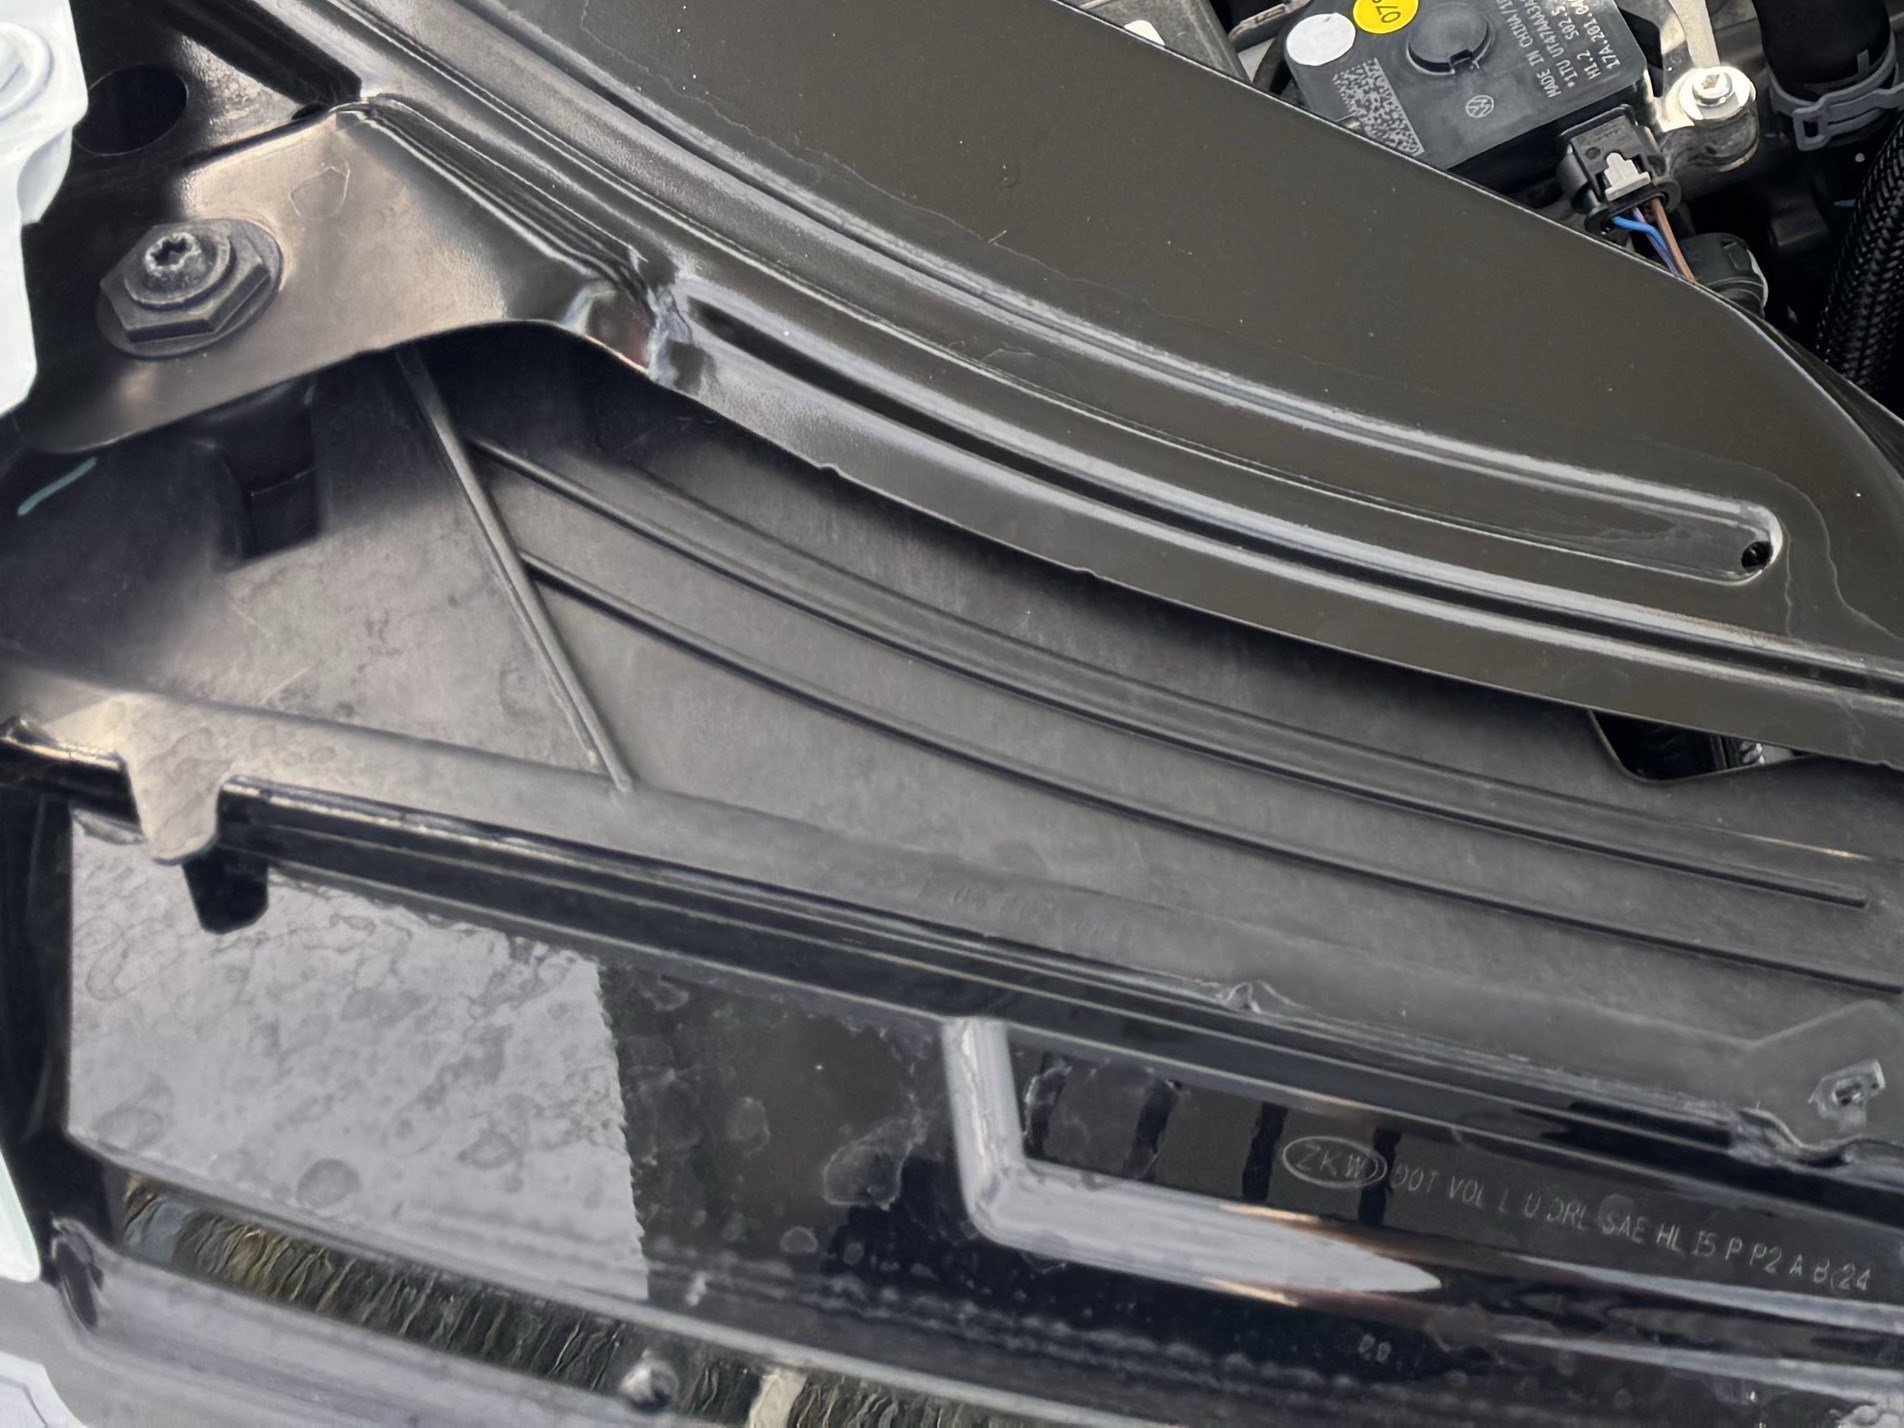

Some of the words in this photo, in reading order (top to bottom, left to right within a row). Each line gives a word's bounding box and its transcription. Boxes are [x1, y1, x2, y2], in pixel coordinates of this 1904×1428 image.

[1525, 48, 1544, 67] IN
[1536, 67, 1561, 99] MADE
[1295, 1143, 1368, 1181] ZKW
[1599, 1209, 1647, 1244] SAE
[1725, 1236, 1744, 1263] P
[1748, 1242, 1783, 1275] P2
